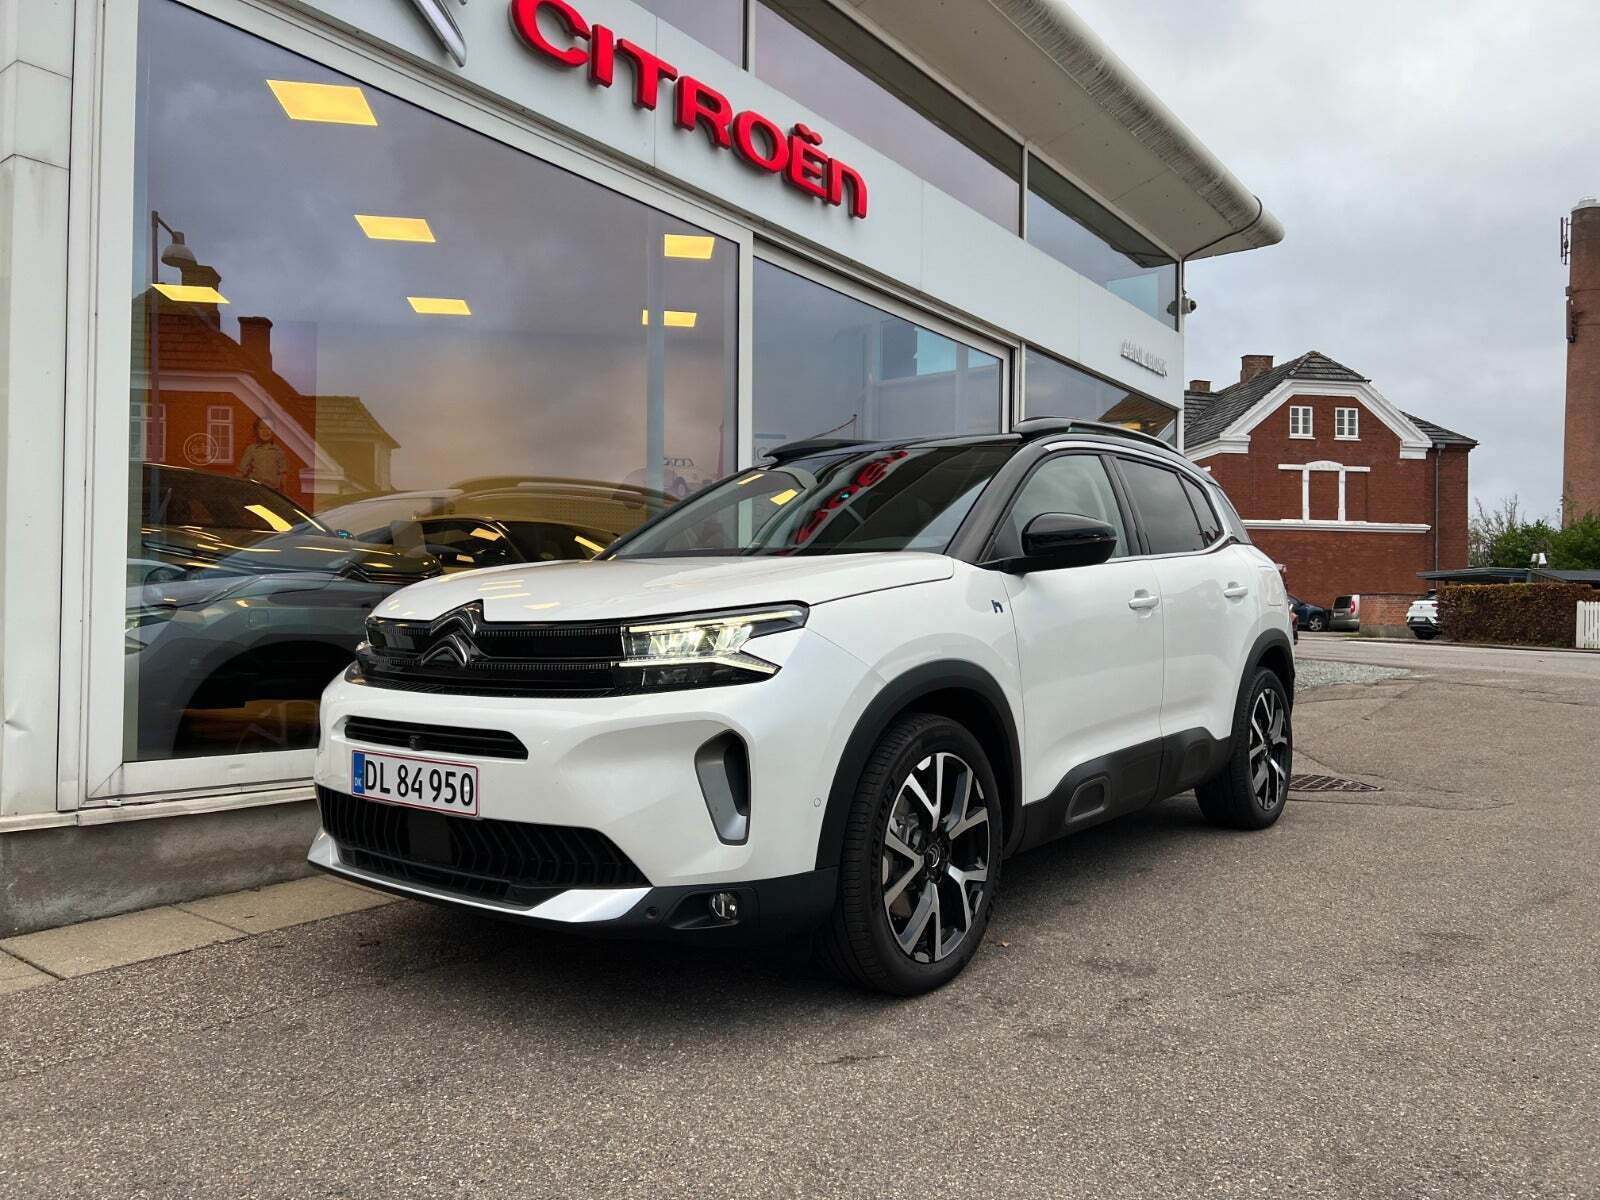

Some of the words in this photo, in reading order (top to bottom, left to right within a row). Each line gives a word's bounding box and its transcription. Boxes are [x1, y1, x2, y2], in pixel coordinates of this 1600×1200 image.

[365, 759, 391, 794] DL
[397, 764, 423, 800] 84
[429, 768, 474, 806] 950
